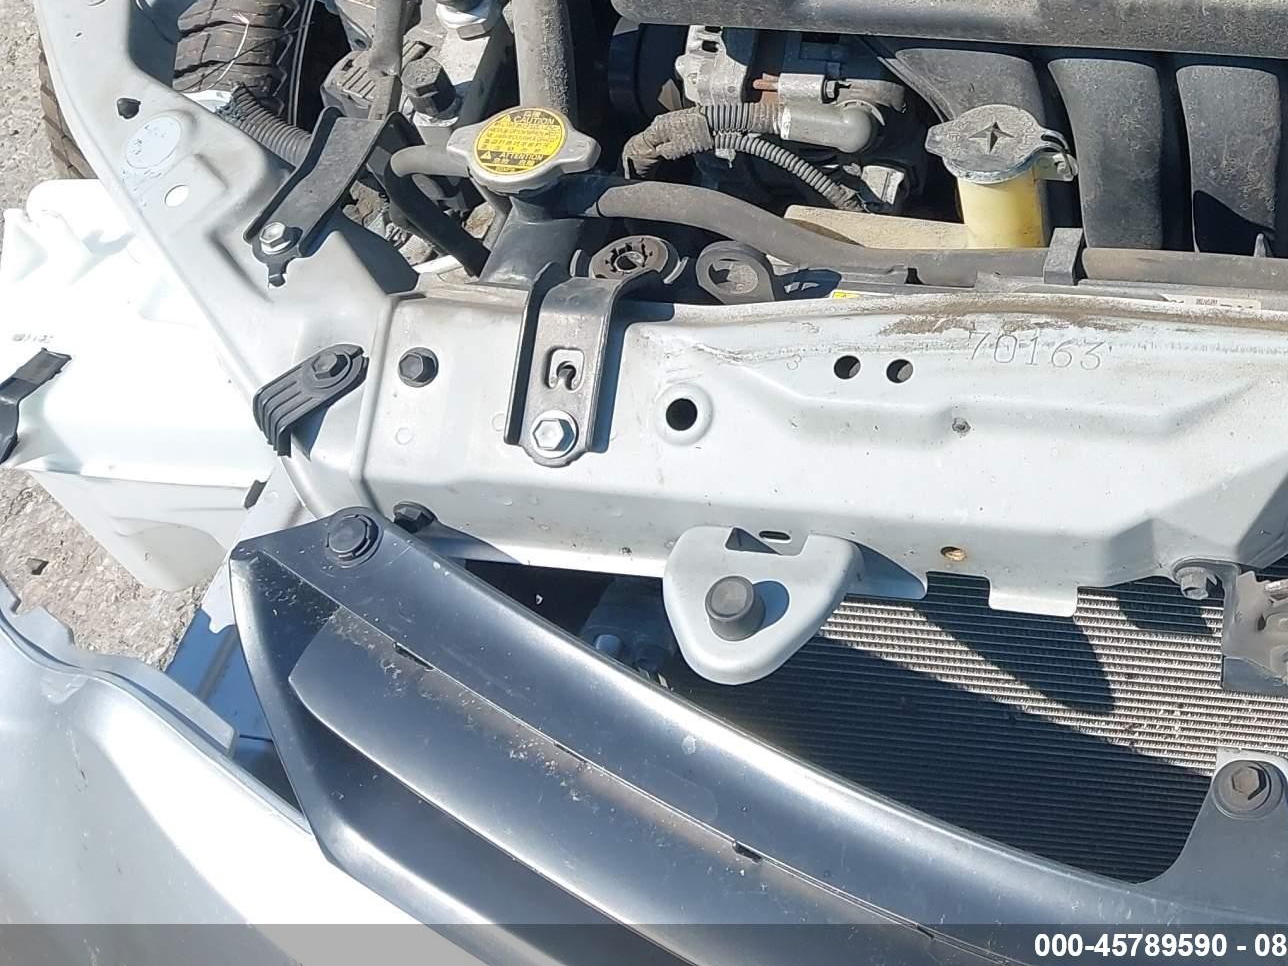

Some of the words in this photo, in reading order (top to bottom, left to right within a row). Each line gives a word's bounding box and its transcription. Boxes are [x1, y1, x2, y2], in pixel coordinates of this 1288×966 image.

[513, 115, 555, 124] CAUTION
[499, 151, 544, 160] ATTENTION
[967, 330, 1105, 371] 70163
